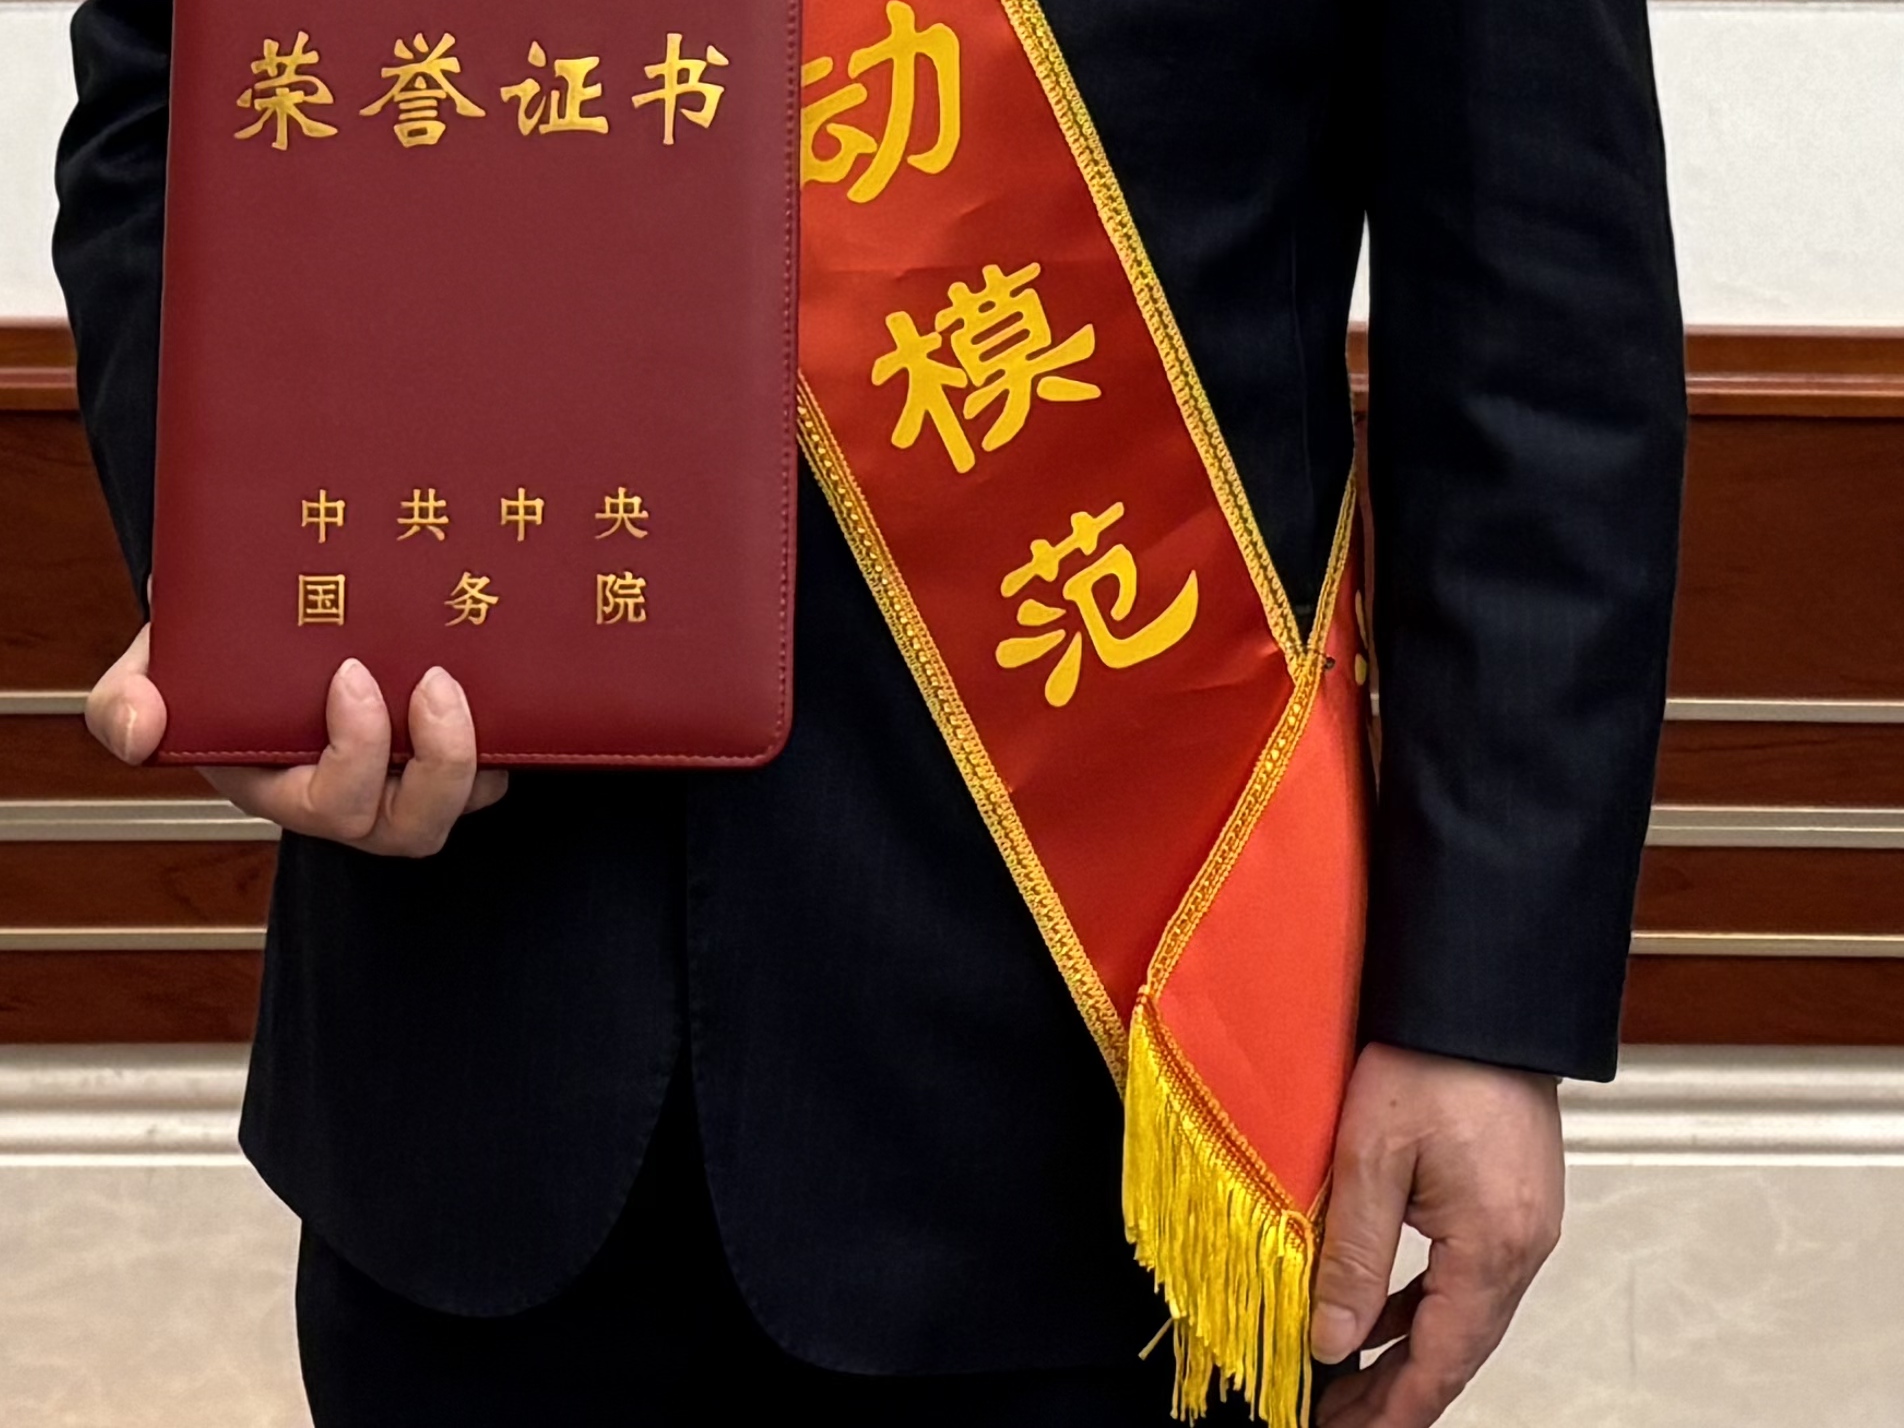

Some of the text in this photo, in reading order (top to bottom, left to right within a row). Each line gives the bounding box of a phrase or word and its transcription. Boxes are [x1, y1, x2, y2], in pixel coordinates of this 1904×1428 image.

[234, 31, 729, 150] 荣誉证书
[301, 486, 649, 543] 中共中央
[297, 570, 648, 626] 国务院
